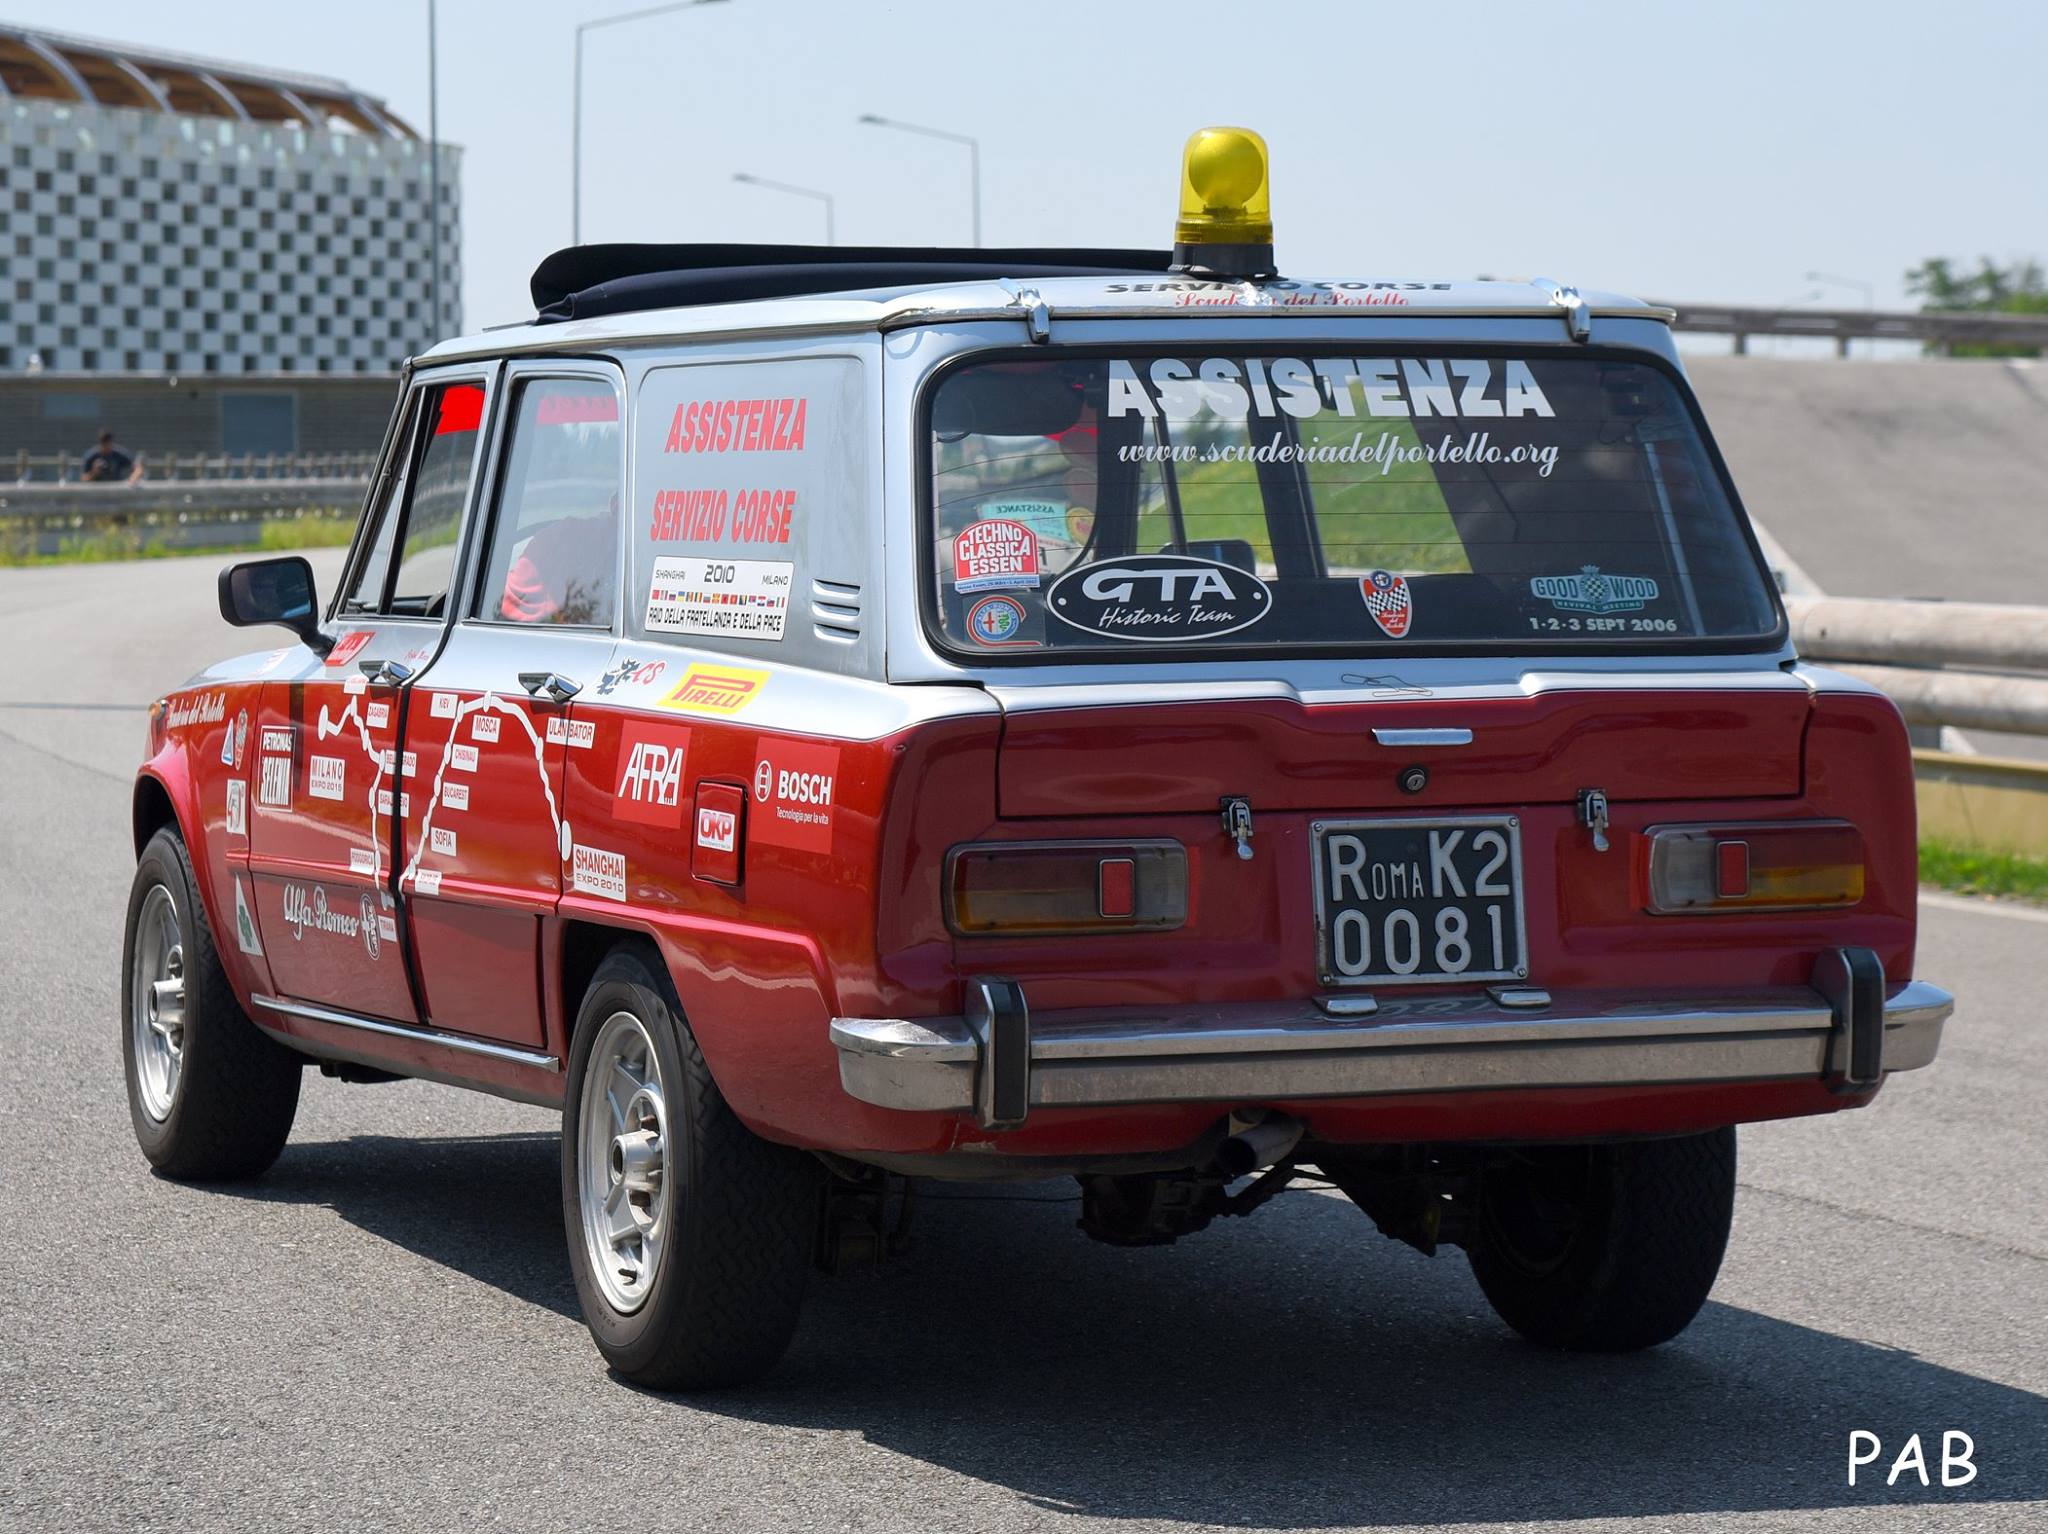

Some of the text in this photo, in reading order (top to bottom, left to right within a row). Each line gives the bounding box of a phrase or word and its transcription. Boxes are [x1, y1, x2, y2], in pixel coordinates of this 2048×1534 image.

[1312, 281, 1453, 291] CORSE
[1107, 358, 1556, 418] ASSISTENZA
[664, 398, 807, 453] ASSISTENZA
[1117, 431, 1560, 478] www.scuderiadelportello.org
[650, 489, 796, 543] SERVIZIO CORSE
[967, 523, 1022, 545] TECHNO
[960, 535, 1031, 561] CLASSICA
[655, 564, 788, 585] SHANGHAI 2010 MILANO
[969, 557, 1022, 576] ESSEN
[1081, 568, 1237, 603] GTA
[1536, 577, 1656, 598] GOOD WOOD
[647, 607, 782, 632] RAID DELLA FRATELLANZA E DELLA PACE
[1099, 604, 1236, 628] Historic Team
[1586, 618, 1626, 631] SEPT
[1631, 619, 1678, 632] 2006
[671, 673, 756, 708] PIRELLI
[475, 716, 497, 735] MOSCA
[549, 719, 593, 741] ULAN BATOR
[262, 732, 292, 752] PETRONAS
[312, 757, 343, 780] MILANO
[618, 742, 684, 806] AFRA
[777, 769, 832, 806] BOSCH
[434, 829, 452, 848] SOFIA
[701, 811, 732, 841] OKP
[575, 848, 623, 880] SHANGHAI
[576, 873, 624, 893] EXPO 2010
[283, 882, 360, 941] Alfa Romeo
[1334, 904, 1504, 976] 0081
